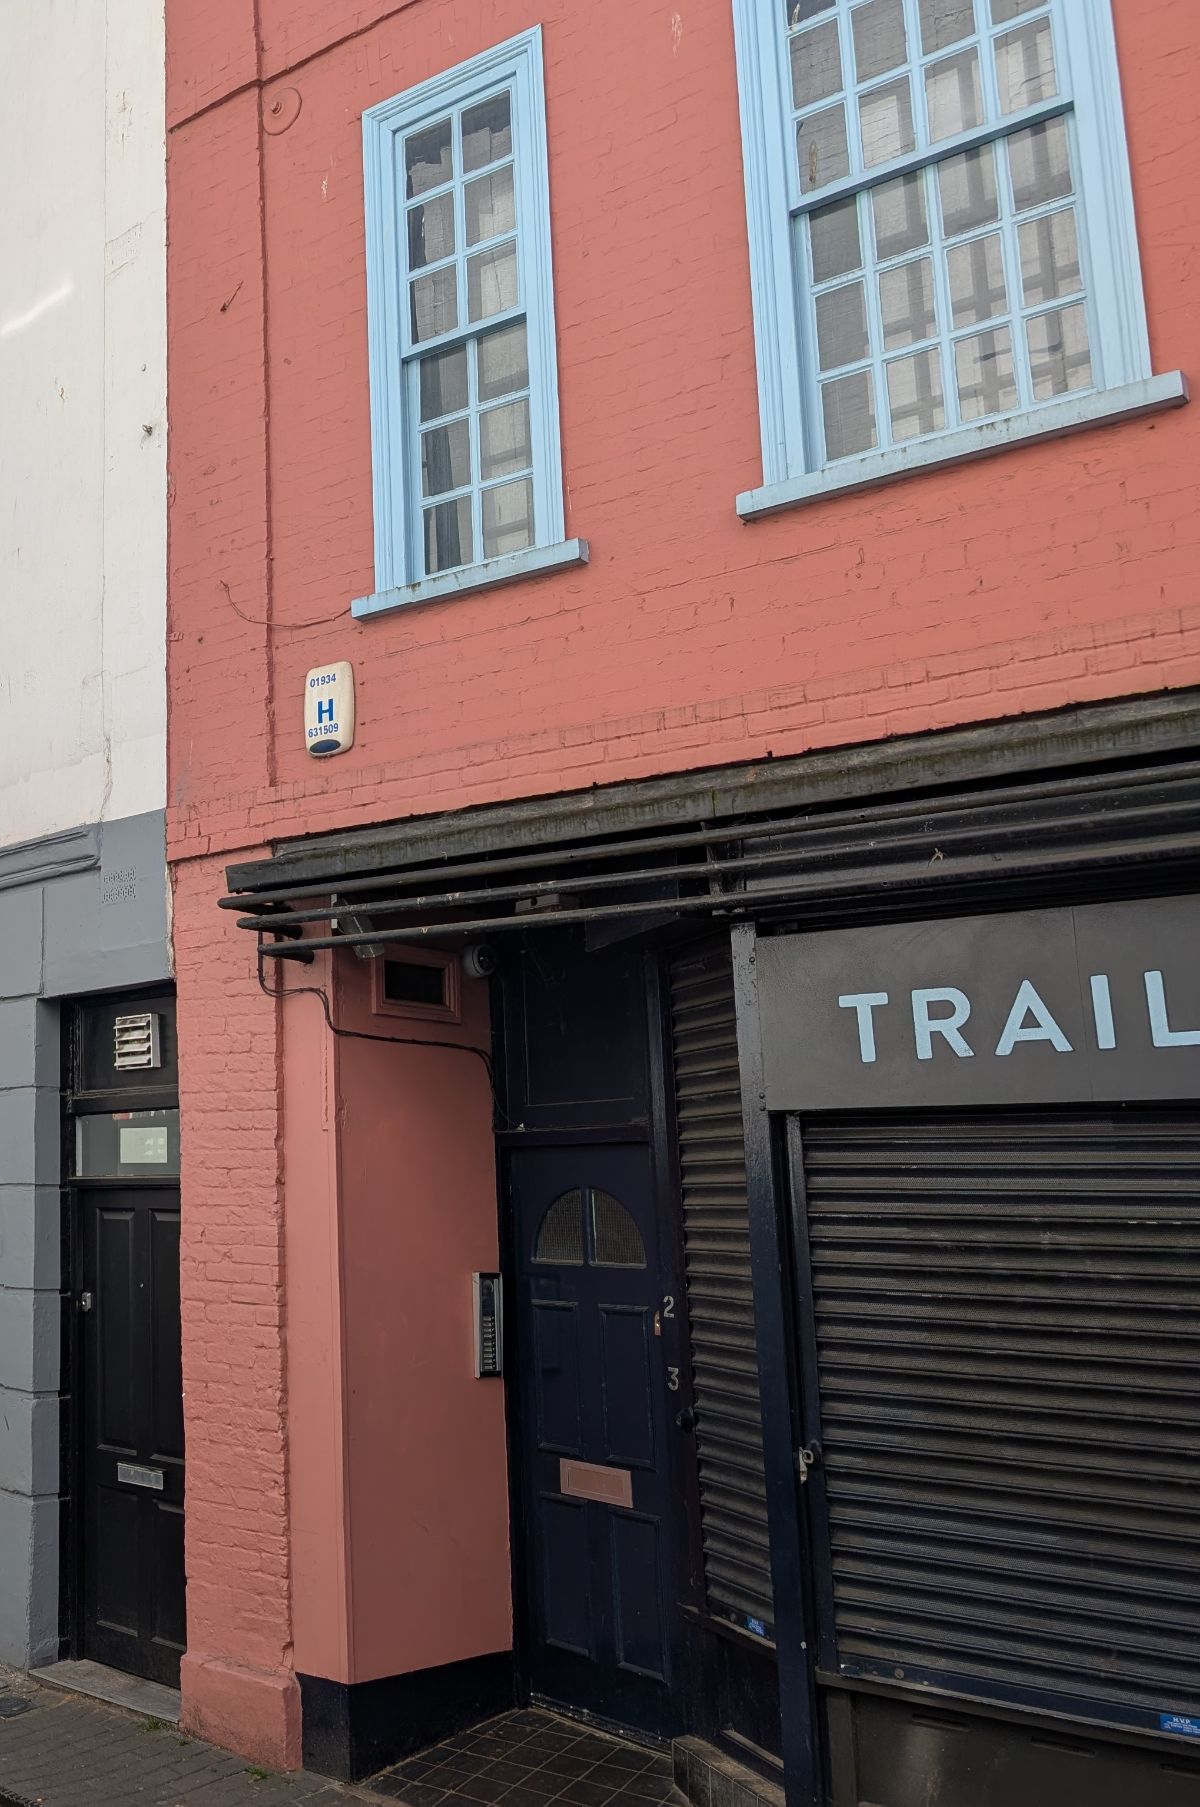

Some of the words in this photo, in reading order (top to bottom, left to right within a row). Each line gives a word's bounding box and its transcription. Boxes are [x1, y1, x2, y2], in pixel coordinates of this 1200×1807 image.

[309, 673, 337, 688] 01934
[317, 698, 334, 724] H
[308, 722, 339, 738] 631509
[838, 970, 1200, 1063] TRAIL
[663, 1295, 675, 1319] 2
[667, 1366, 680, 1391] 3
